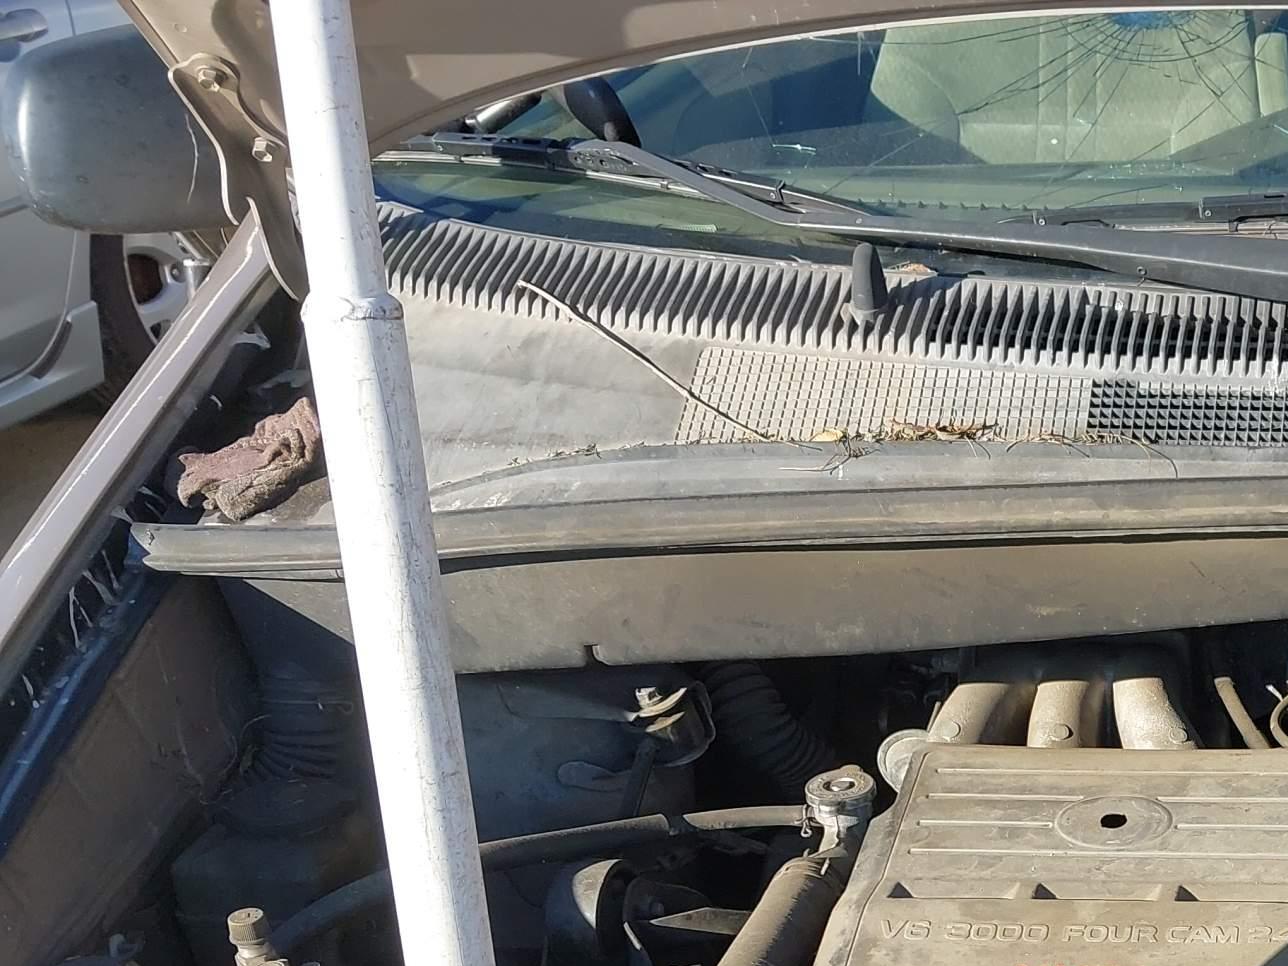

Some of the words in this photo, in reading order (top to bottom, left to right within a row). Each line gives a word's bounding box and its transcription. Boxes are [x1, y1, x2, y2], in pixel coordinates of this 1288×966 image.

[880, 918, 931, 940] V6
[943, 919, 1050, 942] 3000
[1062, 923, 1159, 944] FOUR
[1166, 924, 1240, 945] CAM
